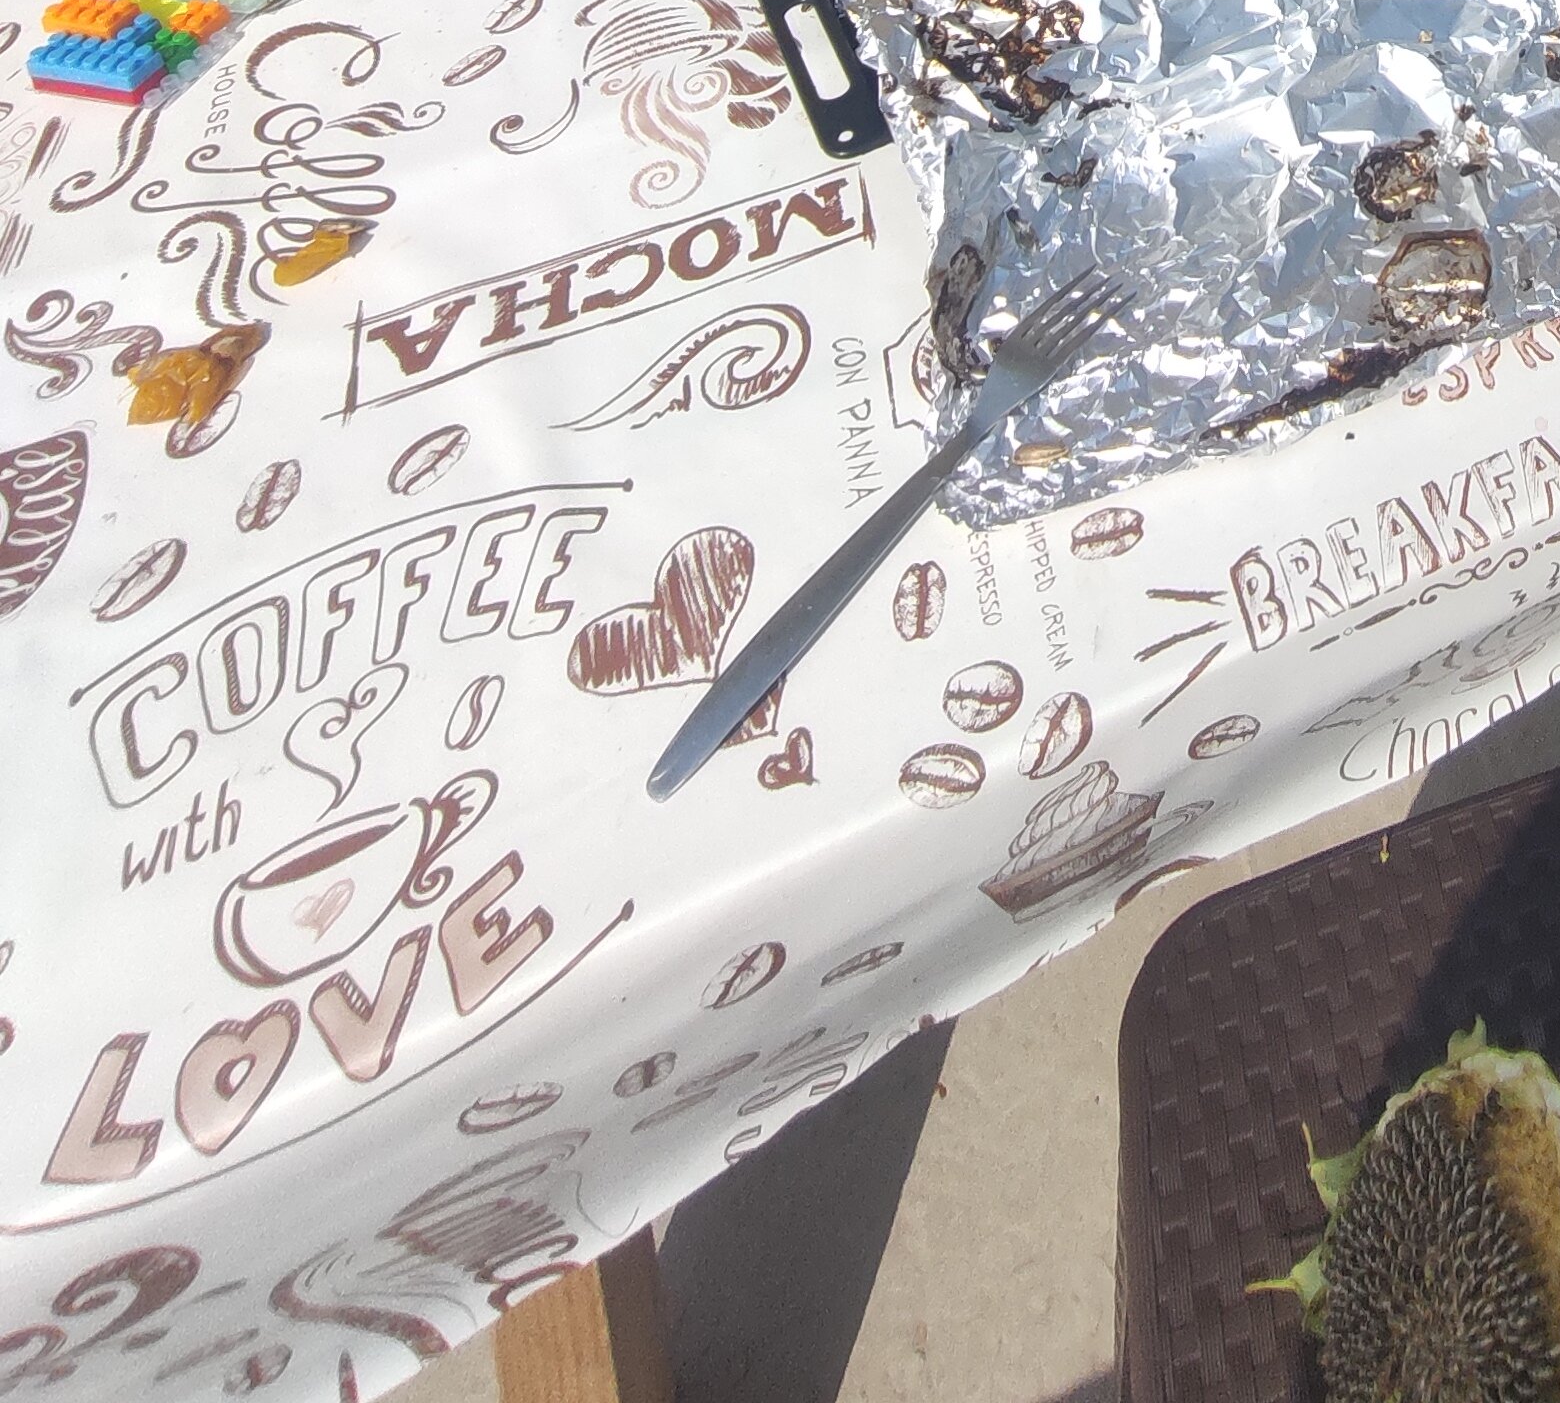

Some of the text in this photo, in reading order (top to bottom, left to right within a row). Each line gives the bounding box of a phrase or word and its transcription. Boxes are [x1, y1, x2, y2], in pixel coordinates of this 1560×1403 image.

[203, 62, 238, 139] HOUSE
[367, 177, 856, 377] MOCHA
[831, 336, 885, 510] CON PANNA
[89, 505, 609, 809] COFFEE
[1024, 519, 1074, 673] HIPPED CREAM
[121, 777, 242, 893] with
[41, 850, 556, 1185] LOVE
